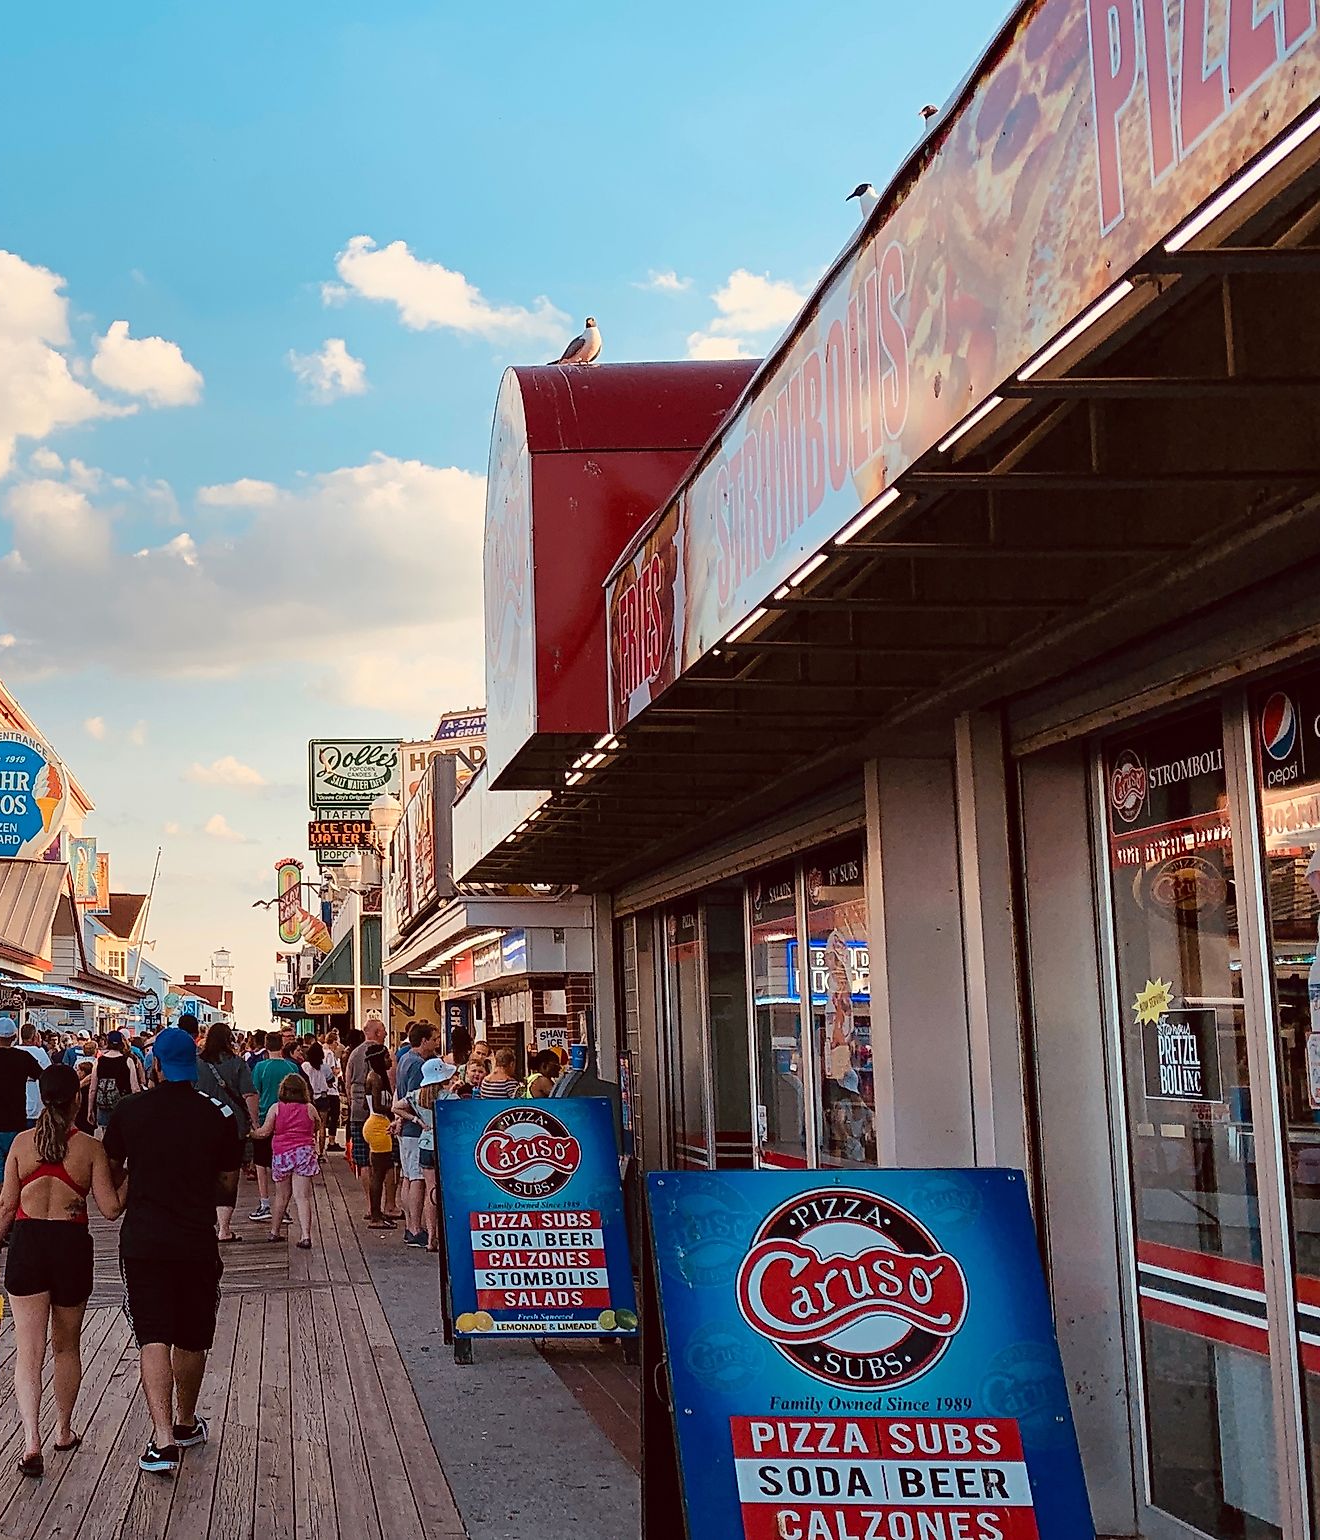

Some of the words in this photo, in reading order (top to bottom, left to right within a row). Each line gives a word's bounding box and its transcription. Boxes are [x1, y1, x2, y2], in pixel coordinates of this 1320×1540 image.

[715, 241, 909, 608] STROMBOLIS
[618, 553, 664, 704] FRIES
[4, 755, 26, 764] 1919
[317, 745, 398, 777] Dolle's
[1149, 749, 1223, 789] STROMBOLI
[1268, 761, 1297, 788] pepsi
[331, 775, 347, 786] SALT
[347, 780, 369, 790] WATER
[369, 778, 385, 788] TAFFY
[325, 810, 365, 819] TAFFY
[314, 823, 338, 833] ICE
[311, 834, 360, 843] WATER
[840, 860, 860, 884] SUBS
[540, 1029, 568, 1042] SHAVE
[547, 1038, 564, 1047] ICE
[1158, 1035, 1201, 1065] PRETZEL
[504, 1111, 544, 1127] PIZZA
[479, 1133, 573, 1176] Caruso
[514, 1181, 551, 1195] SUBS
[488, 1202, 513, 1210] Family
[541, 1201, 561, 1209] Since
[797, 1197, 888, 1229] PIZZA
[479, 1213, 532, 1228] PIZZA
[541, 1213, 592, 1227] SUBS
[481, 1233, 532, 1247] SODA
[545, 1232, 594, 1246] BEER
[488, 1251, 590, 1267] CALZONES
[485, 1271, 599, 1286] STOMBOLIS
[504, 1291, 583, 1307] SALADS
[748, 1254, 952, 1332] Caruso
[517, 1313, 538, 1321] Fresh
[540, 1313, 574, 1322] Squeezed
[496, 1323, 547, 1331] LEMONADE
[549, 1323, 556, 1331] &
[557, 1322, 597, 1331] LIMEADE
[824, 1352, 902, 1382] SUBS
[770, 1395, 823, 1413] Family
[828, 1396, 882, 1412] Owned
[886, 1396, 930, 1412] Since
[934, 1396, 972, 1412] 1989
[751, 1422, 869, 1454] PIZZA
[889, 1423, 1002, 1455] SUBS
[758, 1465, 873, 1498] SODA
[899, 1467, 1010, 1499] BEER
[778, 1508, 1004, 1540] CALZONES
